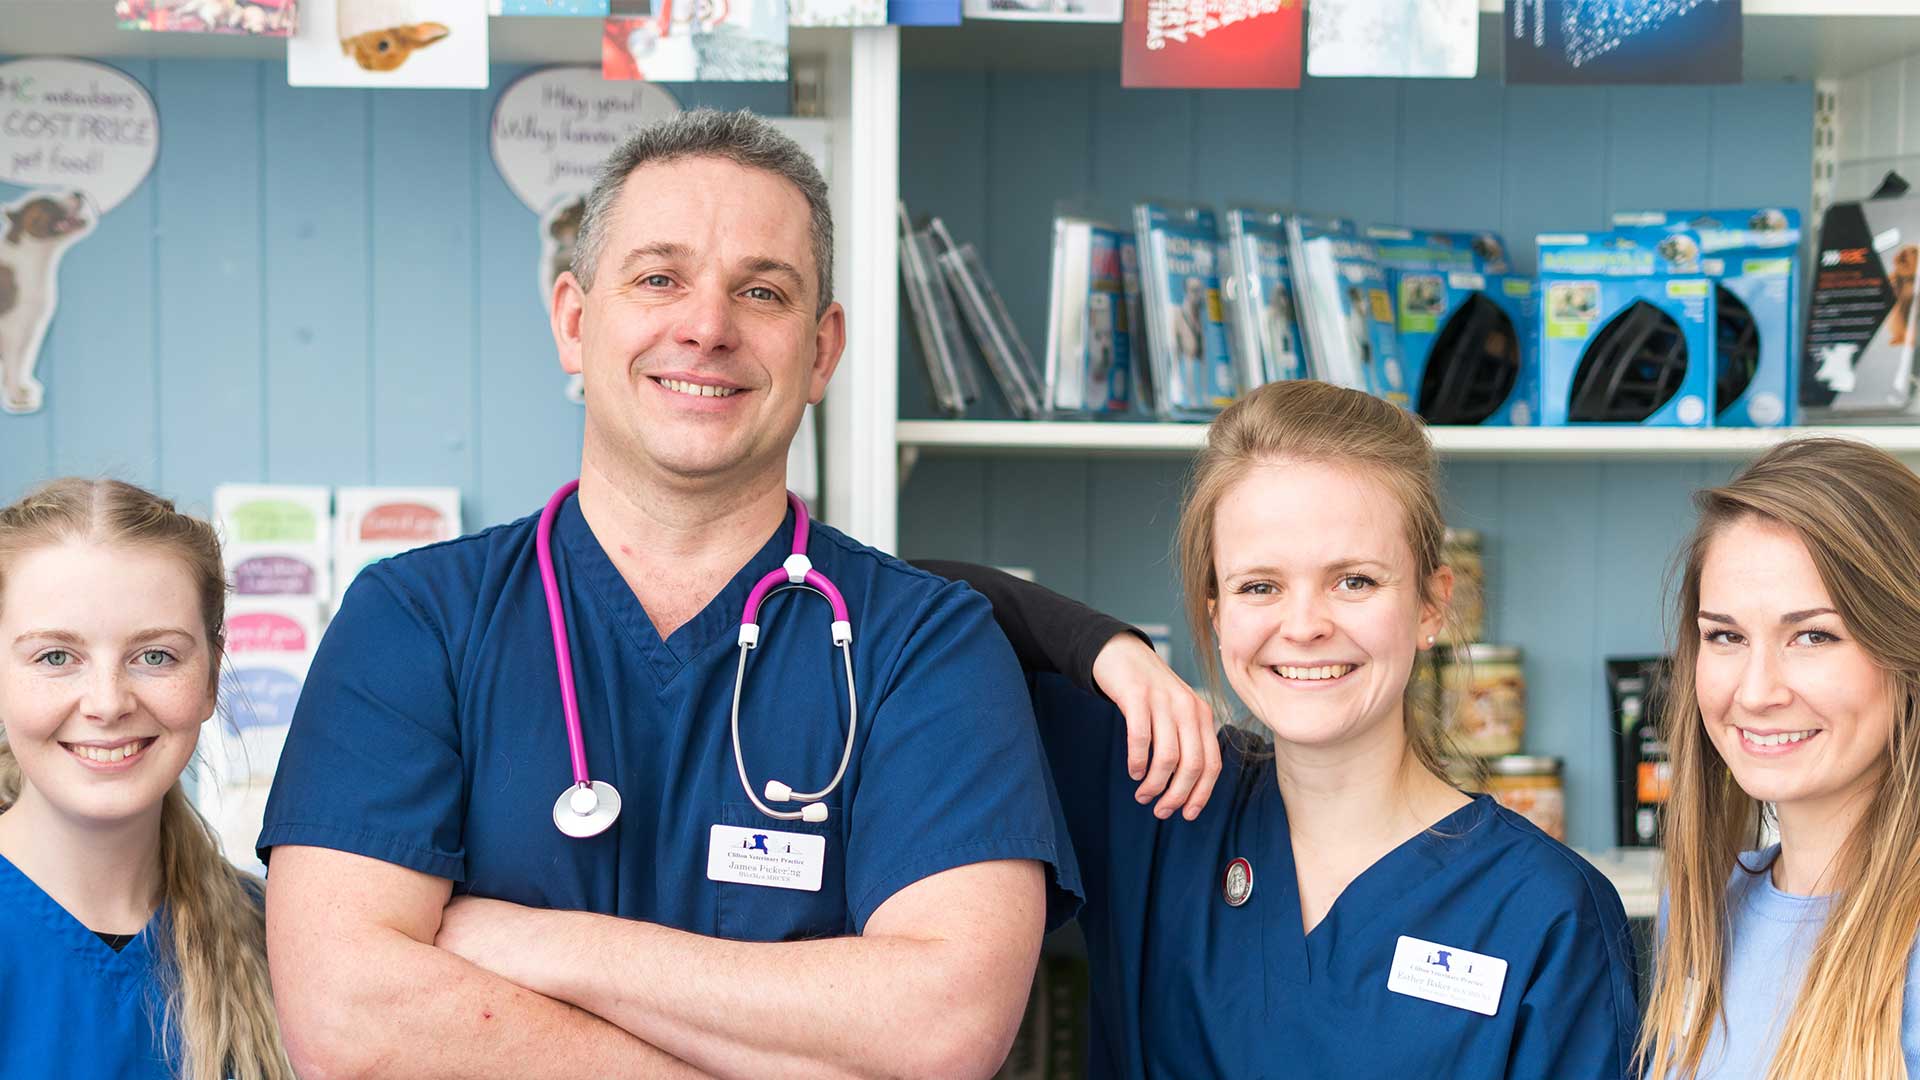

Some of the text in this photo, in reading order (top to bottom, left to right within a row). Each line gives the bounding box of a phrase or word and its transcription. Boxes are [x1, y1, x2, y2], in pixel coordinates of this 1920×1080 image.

[3, 110, 148, 146] COST PRICE
[728, 861, 757, 872] James
